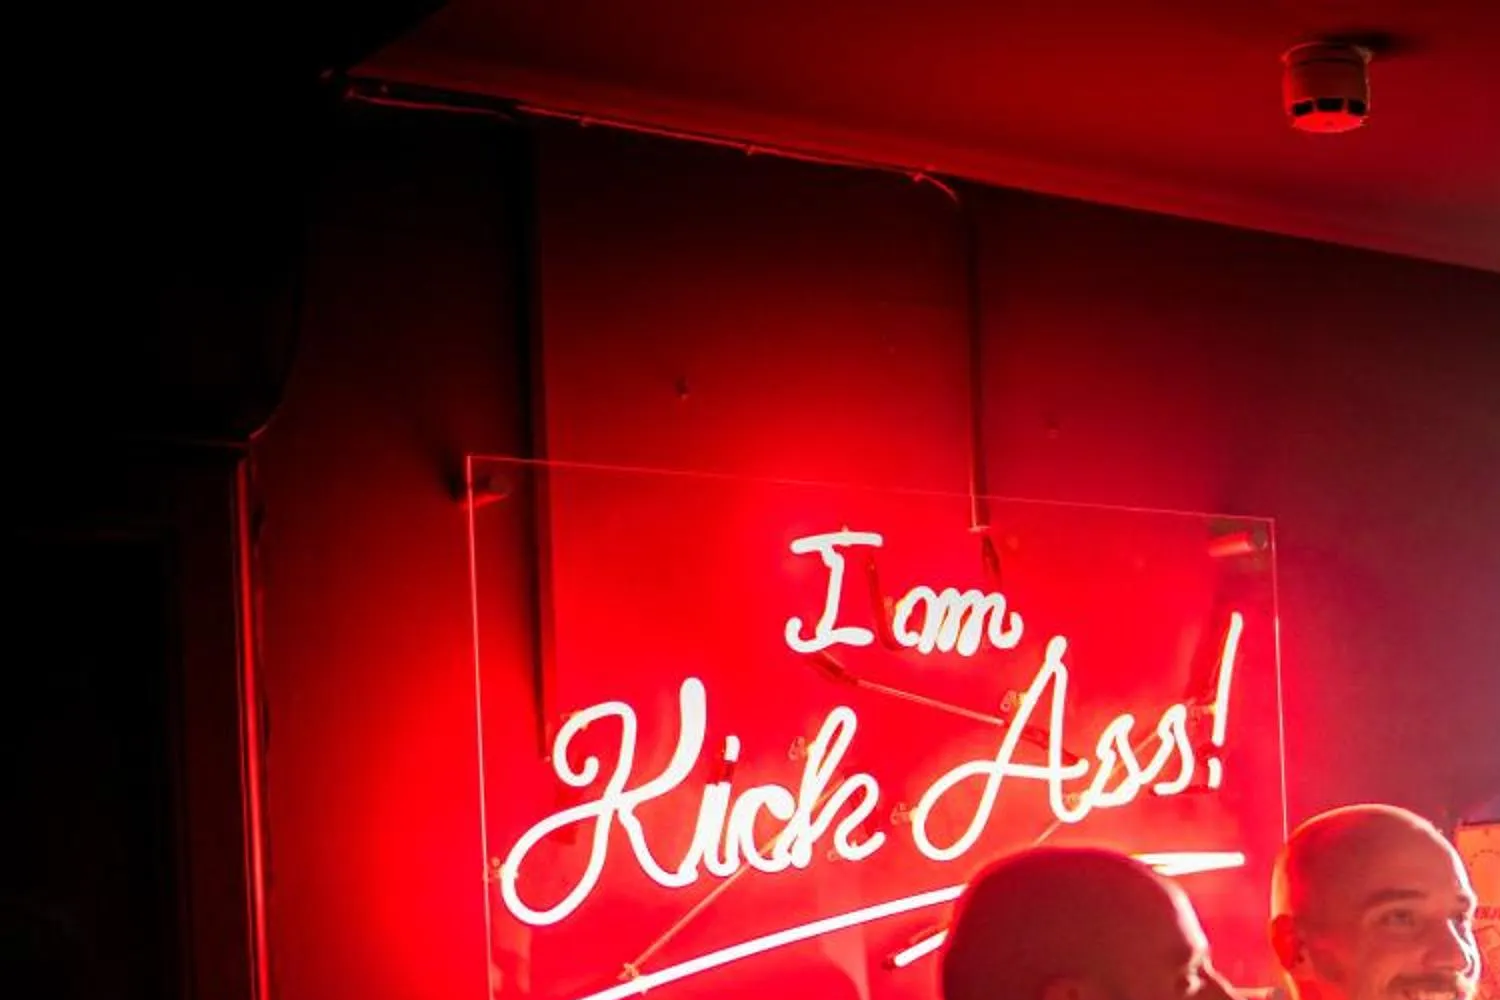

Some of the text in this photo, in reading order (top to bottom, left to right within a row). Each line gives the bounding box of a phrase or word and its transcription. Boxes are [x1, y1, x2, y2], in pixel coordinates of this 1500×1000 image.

[785, 529, 1024, 656] I am
[501, 611, 1244, 925] Kick Ass!
